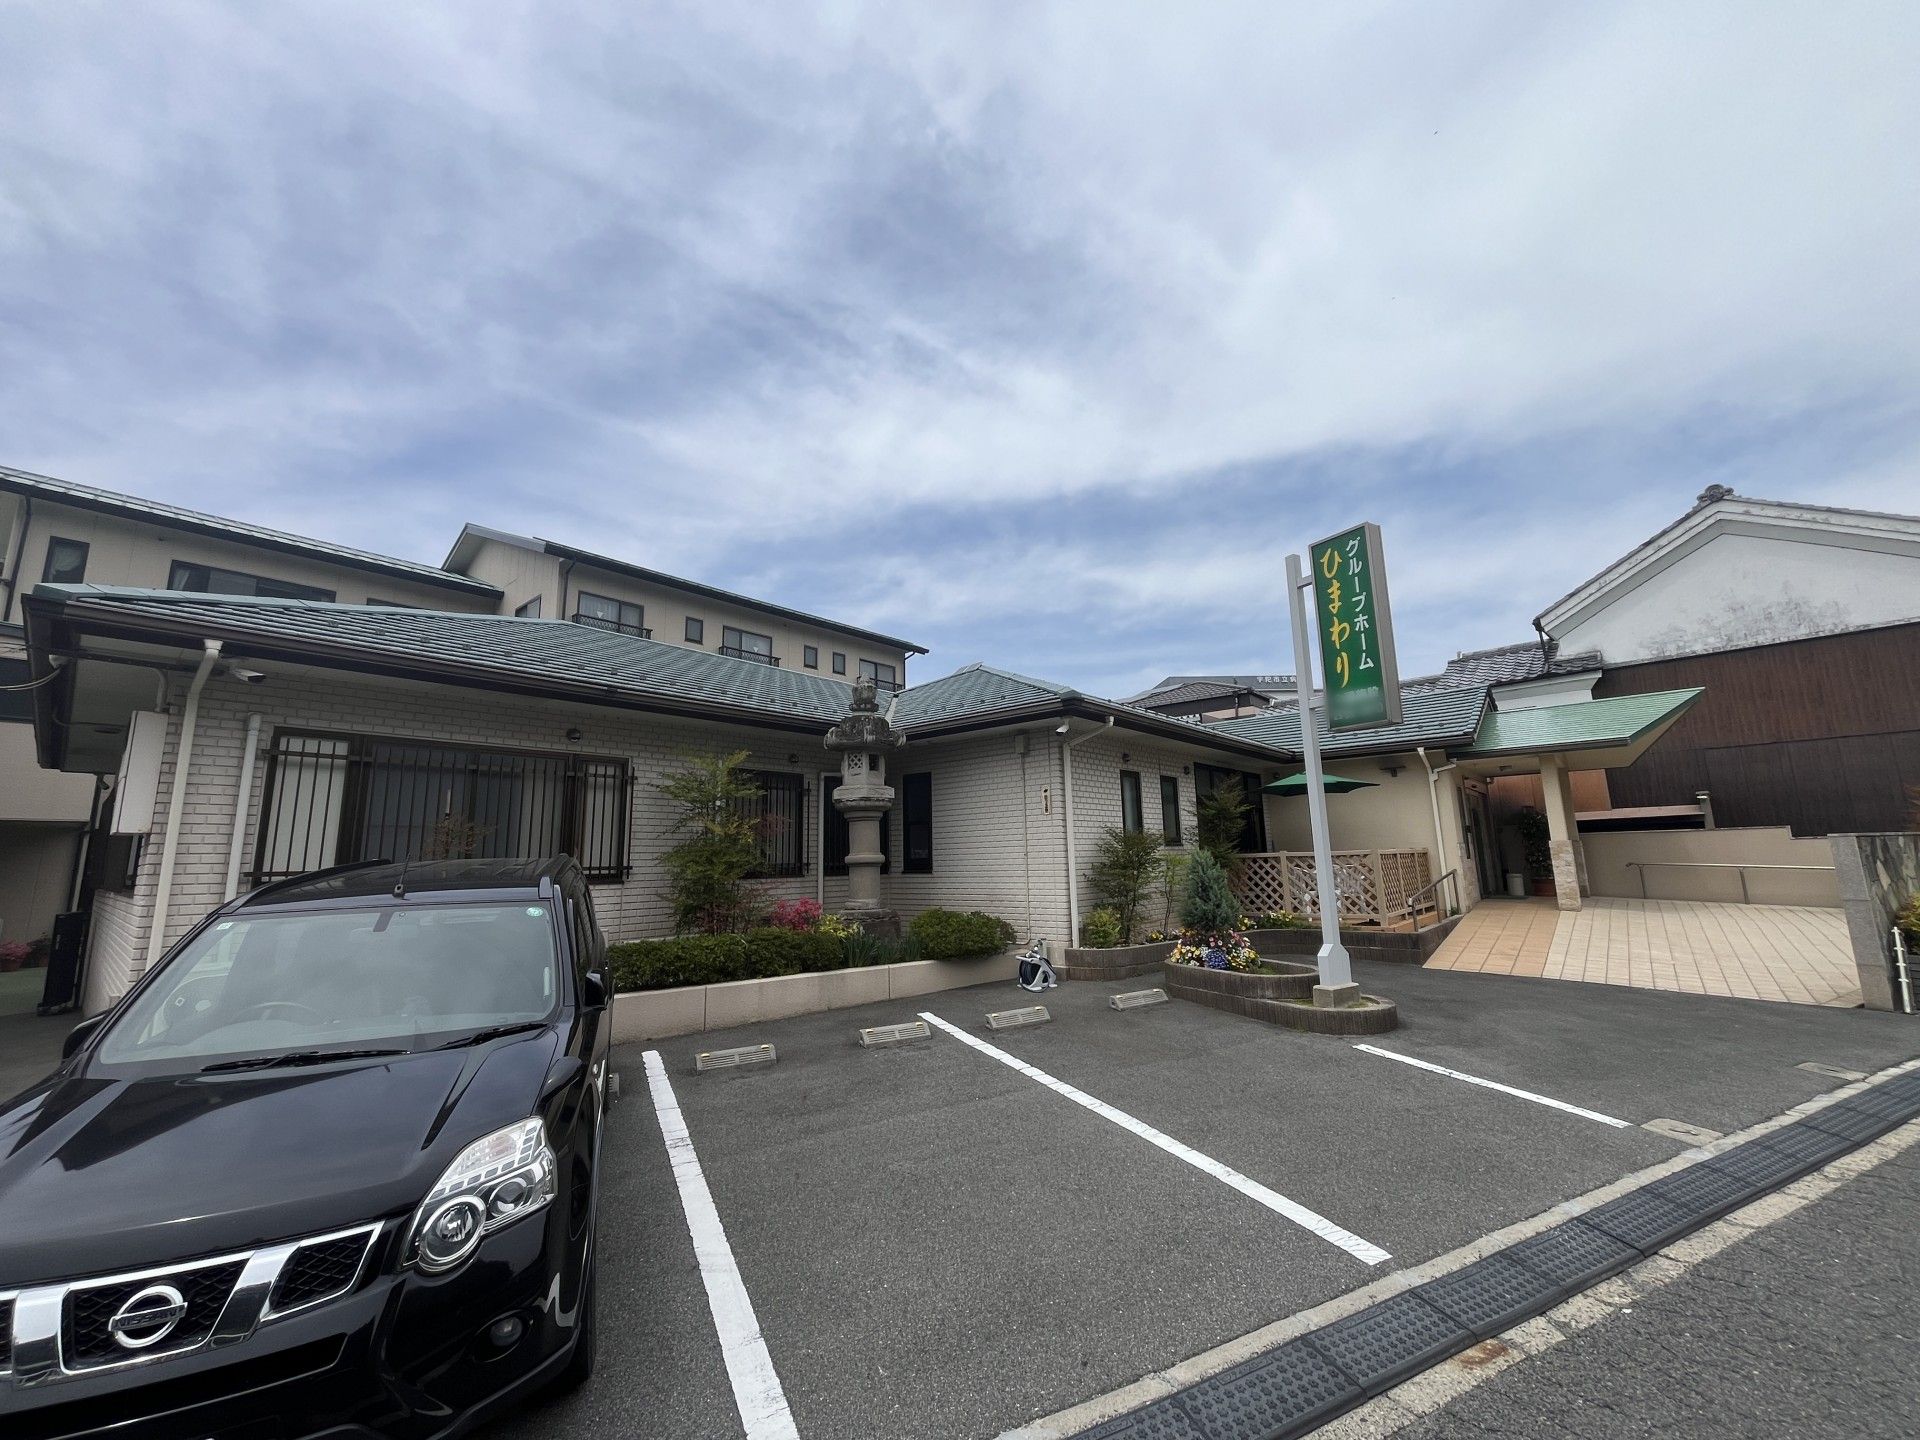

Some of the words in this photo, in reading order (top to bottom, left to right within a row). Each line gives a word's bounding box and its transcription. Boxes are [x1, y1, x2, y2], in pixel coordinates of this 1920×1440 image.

[1320, 548, 1350, 688] ひまわり
[1346, 537, 1374, 669] グループホーム
[113, 1305, 182, 1328] NISSAN
